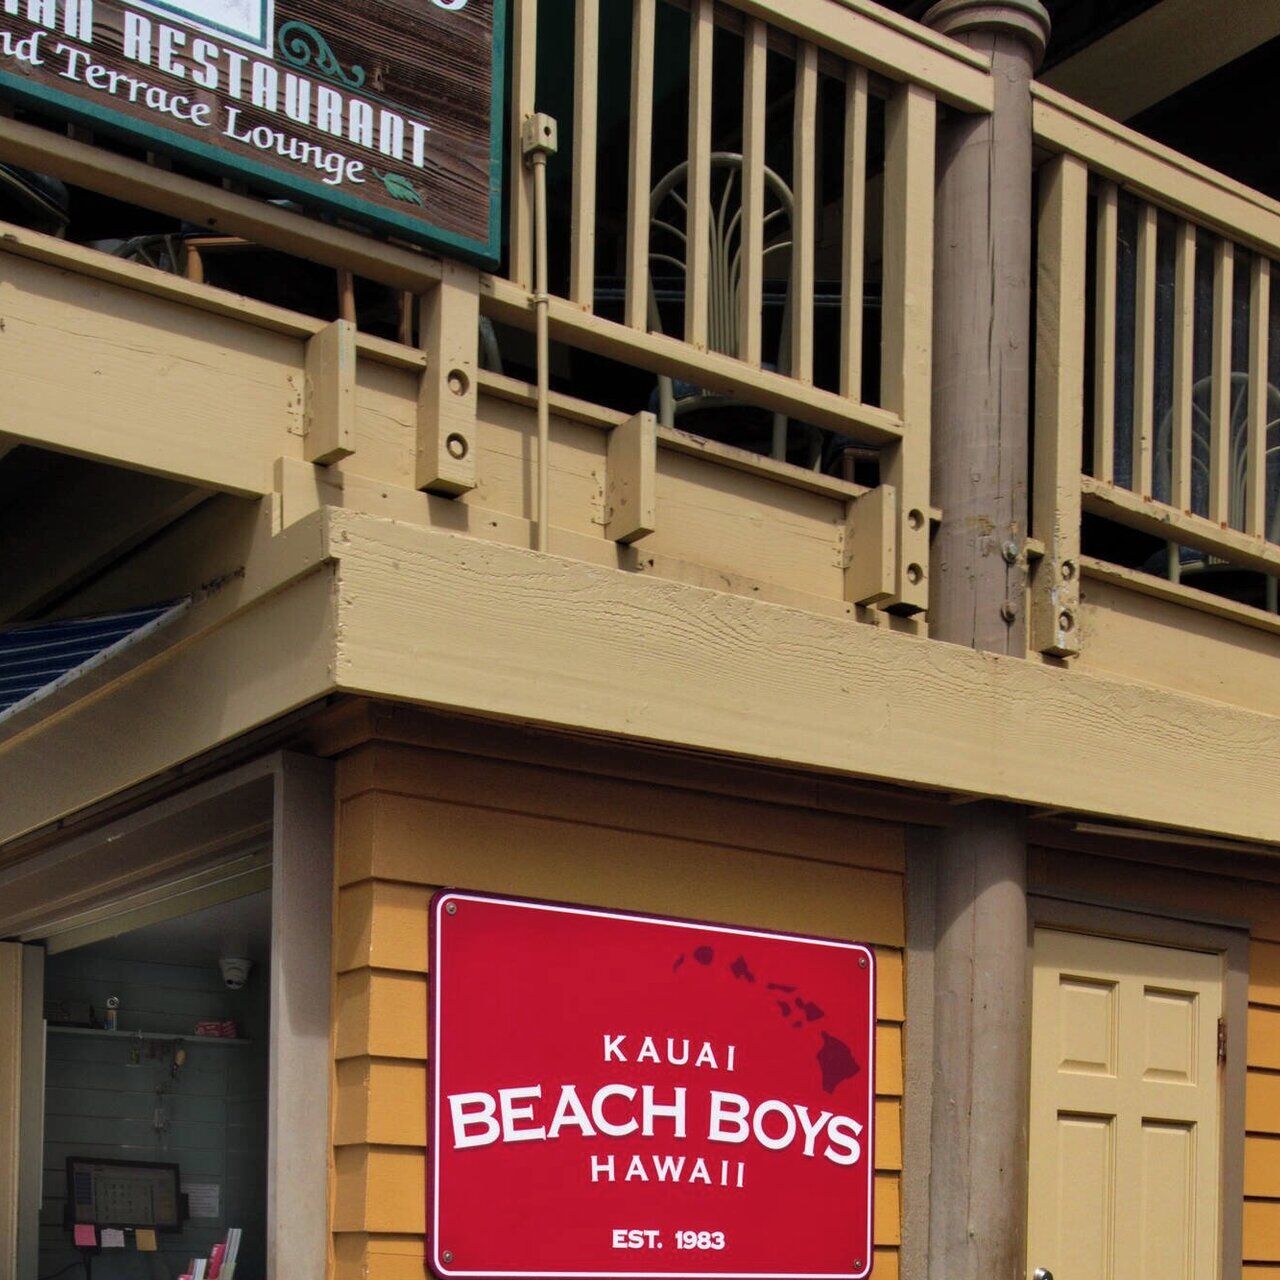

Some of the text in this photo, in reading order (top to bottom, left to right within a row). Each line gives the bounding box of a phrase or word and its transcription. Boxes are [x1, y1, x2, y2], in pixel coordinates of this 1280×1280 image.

[55, 42, 212, 128] Terrace
[222, 106, 366, 185] Lounge
[123, 10, 431, 168] RESTAURANT
[603, 1034, 736, 1071] KAUAI
[447, 1083, 864, 1166] BEACH BOYS
[591, 1155, 745, 1188] HAWAII
[612, 1229, 726, 1251] EST. 1983
